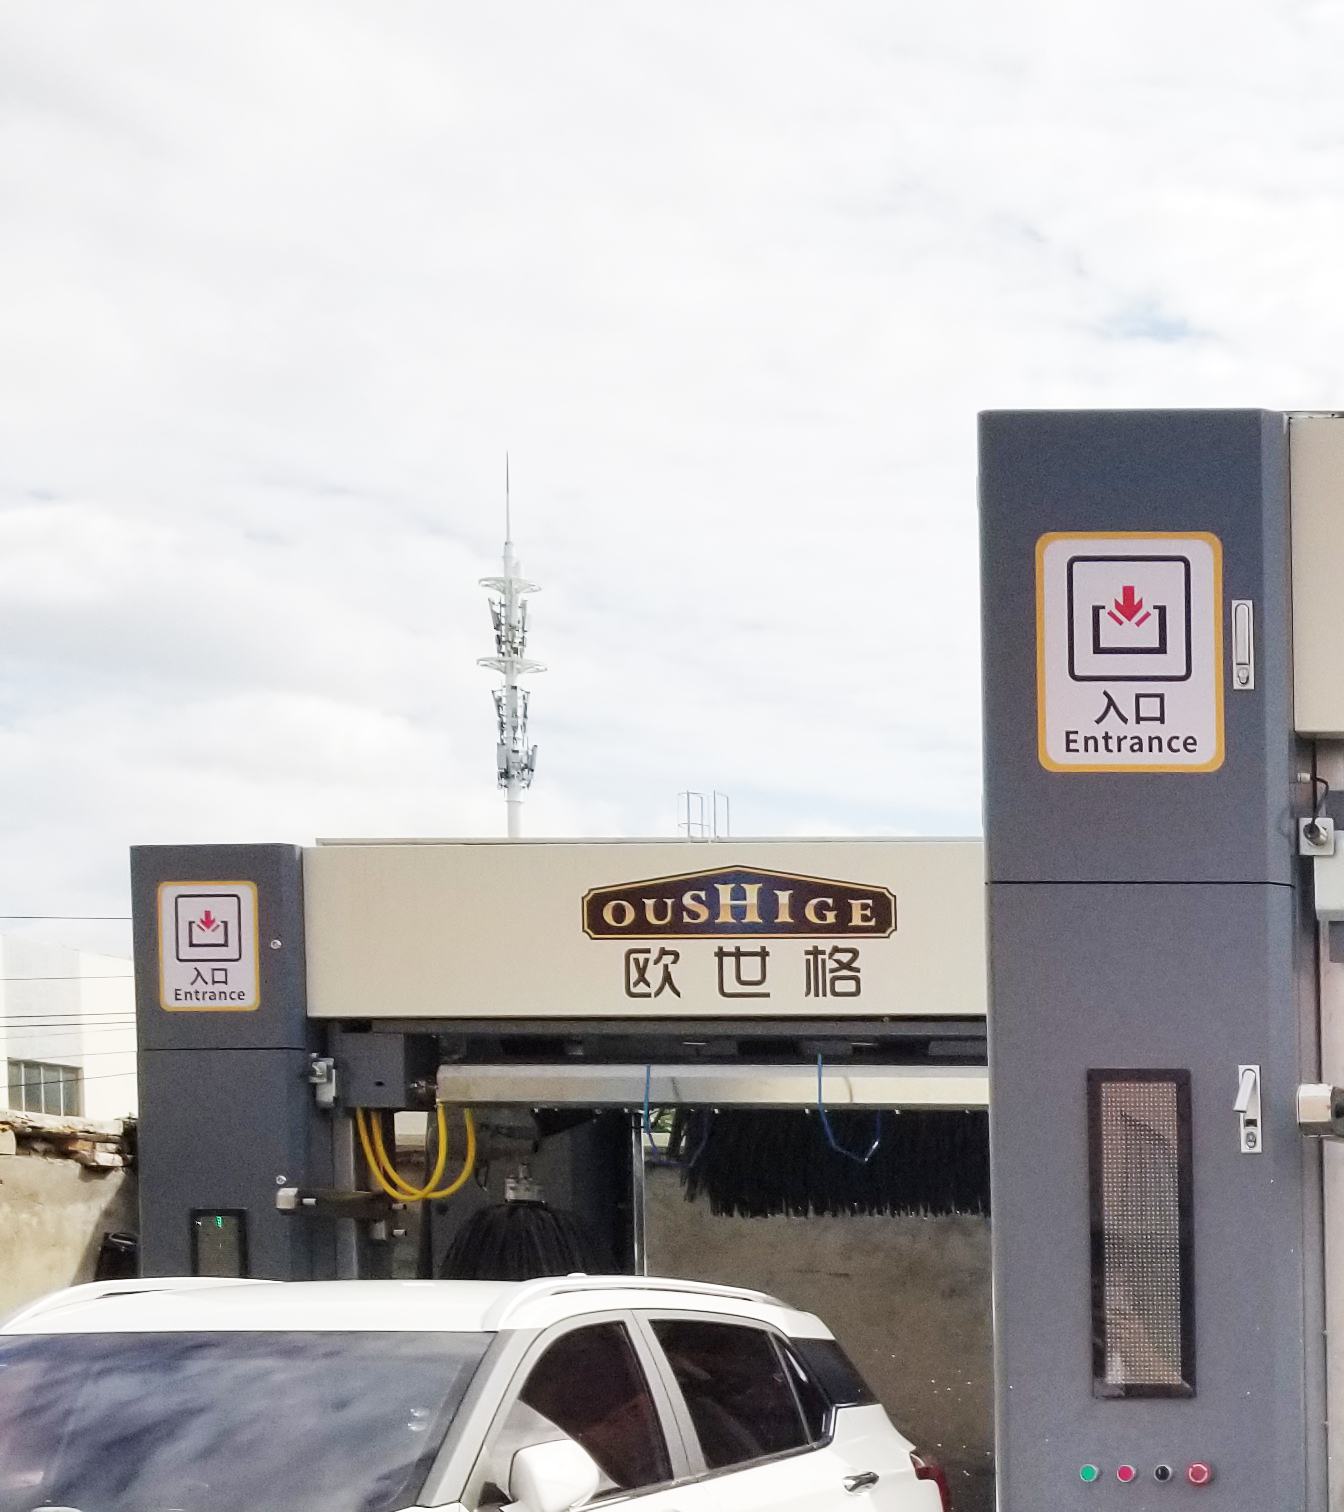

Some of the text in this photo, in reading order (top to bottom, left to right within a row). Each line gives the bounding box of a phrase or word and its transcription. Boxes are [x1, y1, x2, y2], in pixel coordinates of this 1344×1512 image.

[1094, 689, 1166, 725] 入口
[1064, 730, 1198, 753] Entrance
[602, 883, 876, 927] OUSHIGE
[190, 967, 228, 986] 入口
[623, 945, 862, 999] 欧世格
[174, 988, 245, 1001] Entrance
